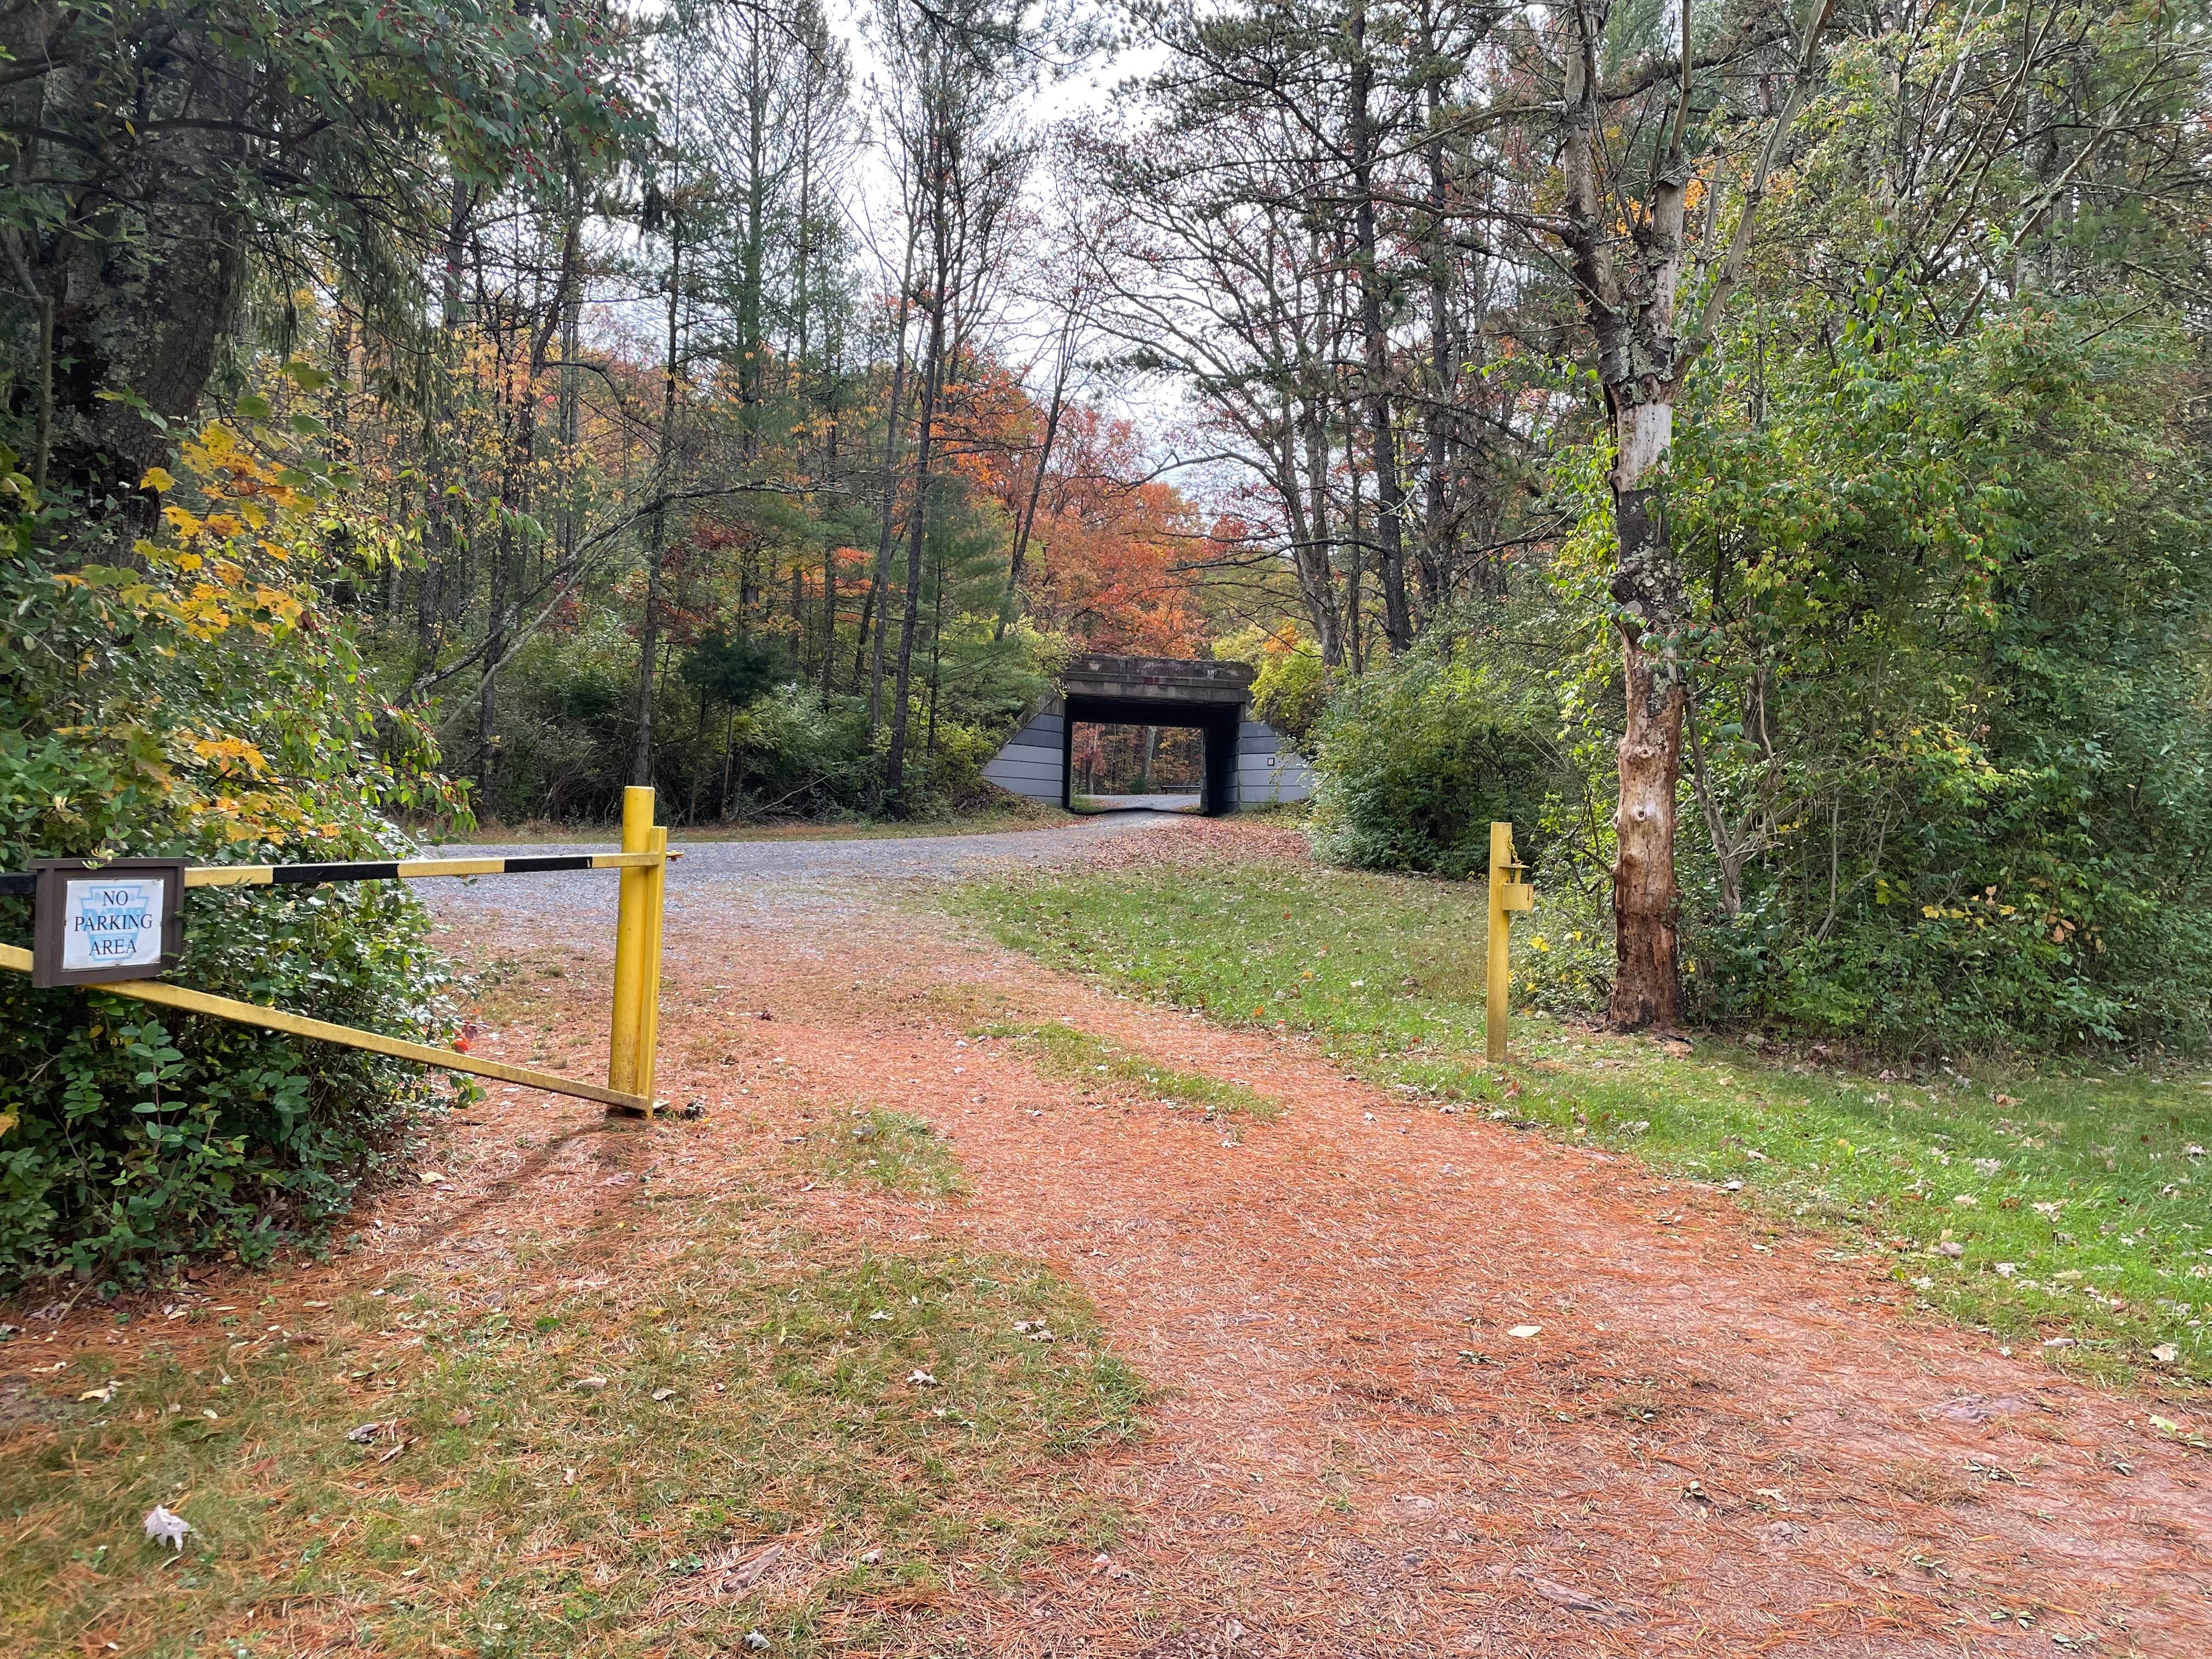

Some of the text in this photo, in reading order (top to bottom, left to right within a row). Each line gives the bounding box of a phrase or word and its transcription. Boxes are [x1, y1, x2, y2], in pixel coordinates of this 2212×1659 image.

[103, 891, 128, 906] NO
[74, 914, 153, 932] PARKING
[88, 939, 137, 956] AREA
